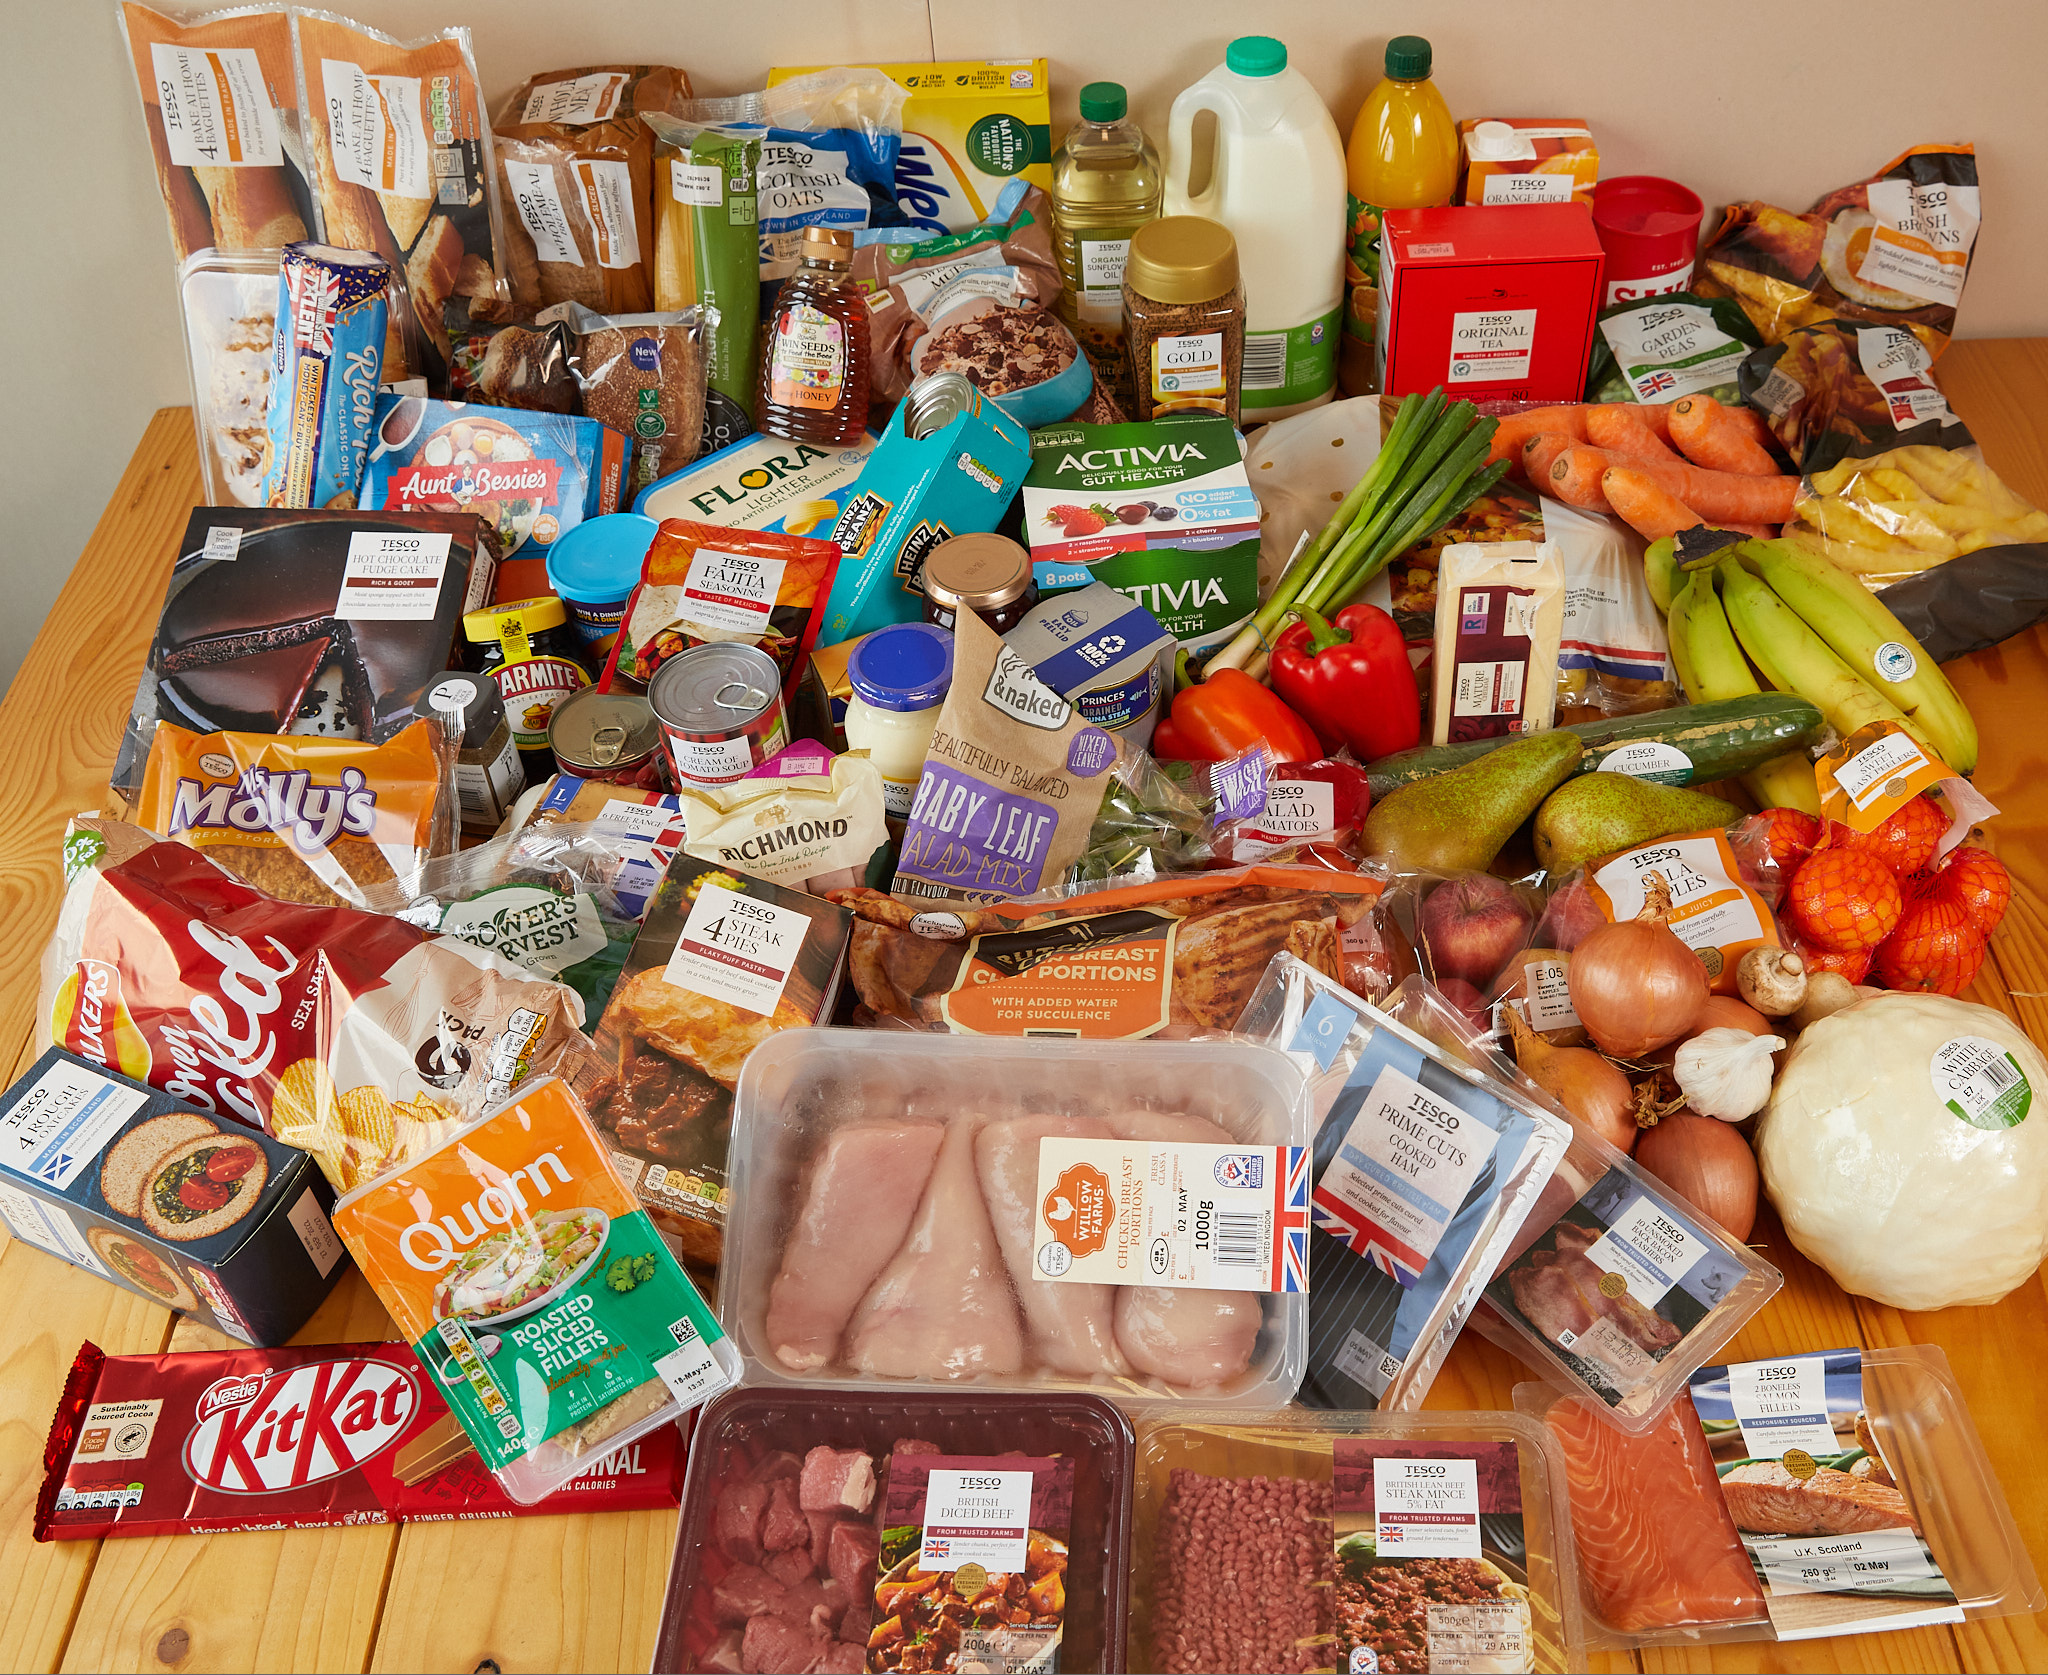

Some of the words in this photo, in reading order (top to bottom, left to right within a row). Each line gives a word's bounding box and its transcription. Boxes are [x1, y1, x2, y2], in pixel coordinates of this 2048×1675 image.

[352, 70, 363, 108] HOME
[162, 81, 178, 130] TESCO
[196, 72, 217, 143] BAGUETTES
[331, 98, 344, 148] TESCO
[351, 111, 362, 128] AT
[363, 94, 376, 166] BAGUETTES
[198, 145, 218, 160] 4
[351, 130, 362, 165] BAKE
[991, 125, 1000, 165] FAVOURITE
[999, 119, 1013, 171] NATION'S
[764, 147, 813, 167] TESCO
[359, 168, 373, 182] 4
[1511, 179, 1546, 188] TESCO
[773, 191, 824, 209] OATS
[520, 193, 543, 232] TESCO
[528, 168, 568, 256] WHOLEMEAL
[548, 198, 567, 236] BREAD
[1104, 271, 1119, 280] OIL
[1458, 326, 1528, 340] ORIGINAL
[1642, 321, 1702, 353] GARDEN
[635, 346, 657, 358] New
[1480, 339, 1504, 349] TEA
[1658, 337, 1697, 359] PEAS
[1167, 350, 1213, 364] GOLD
[307, 383, 317, 423] TICKETS
[795, 390, 832, 403] HONEY
[1056, 443, 1207, 475] ACTIVIA
[400, 471, 457, 499] Aunt
[476, 467, 547, 496] Bessie's
[689, 444, 830, 516] FLORA
[1081, 475, 1116, 487] GUT
[1121, 469, 1185, 484] HEALTH
[742, 496, 788, 523] ARTIFICIAL
[788, 467, 846, 498] INGREDIENTS
[746, 475, 811, 510] LIGHTER
[1180, 492, 1207, 504] NO
[1209, 489, 1235, 498] added
[841, 500, 875, 552] BEANZ
[1196, 527, 1217, 535] cherry
[901, 528, 930, 572] HEINZ
[1079, 537, 1110, 547] raspberry
[353, 554, 376, 564] HOT
[377, 555, 442, 564] CHOCOLATE
[362, 565, 398, 574] FUDGE
[399, 565, 429, 574] CAKE
[703, 565, 766, 590] FAJITA
[1046, 573, 1056, 585] 8
[1058, 572, 1086, 584] pots
[699, 579, 764, 599] SEASONING
[1081, 642, 1111, 665] 100%
[527, 692, 566, 704] EXTRACT
[1081, 690, 1125, 706] PRINCES
[1473, 670, 1485, 709] MATURE
[1083, 702, 1122, 717] DRAINED
[1076, 733, 1107, 752] MIXED
[679, 761, 720, 774] TOMATO
[722, 760, 749, 773] SOUP
[684, 755, 720, 766] CREAM
[724, 755, 739, 765] OF
[929, 730, 1010, 779] BEAUTIFULLY
[1010, 765, 1069, 800] BALANCED
[1072, 750, 1102, 769] LEAVES
[1614, 760, 1670, 772] CUCUMBER
[1860, 751, 1894, 775] SWEET
[236, 766, 266, 795] Ms
[1851, 773, 1873, 794] EASY
[1874, 748, 1917, 775] PEELERS
[554, 789, 567, 801] L
[170, 770, 375, 849] Molly's
[626, 806, 653, 815] TESCO
[910, 771, 987, 840] BABY
[983, 802, 1050, 864] LEAF
[719, 818, 848, 862] RICHMOND
[1630, 848, 1680, 865] TESCO
[975, 855, 1032, 892] MIX
[911, 880, 949, 899] FLAVOUR
[732, 900, 776, 921] TESCO
[1689, 898, 1714, 913] JUICY
[703, 916, 726, 942] 4
[729, 919, 784, 946] STEAK
[724, 933, 759, 955] PIES
[526, 954, 557, 965] Grown
[1038, 966, 1157, 982] PORTIONS
[1536, 967, 1563, 980] E:05
[992, 997, 1024, 1006] WITH
[1028, 998, 1064, 1007] ADDED
[1068, 998, 1118, 1007] WATER
[521, 1015, 535, 1032] 0.30g
[997, 1010, 1024, 1019] FOR
[1027, 1010, 1111, 1020] SUCCULENCE
[1317, 1015, 1335, 1037] 6
[1941, 1042, 1980, 1073] WHITE
[504, 1062, 515, 1077] 0.3g
[1948, 1047, 1997, 1090] CABBAGE
[27, 1085, 78, 1133] ROUGH
[39, 1088, 89, 1139] OATCAKES
[1412, 1093, 1460, 1130] TESCO
[19, 1136, 36, 1150] 4
[1378, 1103, 1428, 1142] PRIME
[1427, 1134, 1467, 1167] CUTS
[1389, 1133, 1437, 1170] COOKED
[1390, 1152, 1420, 1177] HAM
[1121, 1155, 1134, 1207] BREAST
[1078, 1180, 1093, 1241] WILLOW
[1178, 1187, 1189, 1213] MAY
[399, 1150, 573, 1272] Quorn
[1130, 1179, 1144, 1247] PORTIONS
[1177, 1219, 1188, 1232] 02
[1195, 1200, 1214, 1251] 1000g
[1264, 1209, 1272, 1239] KINGDOM
[1656, 1216, 1685, 1242] TESCO
[1117, 1209, 1128, 1269] CHICKEN
[1263, 1239, 1271, 1264] UNITED
[1631, 1236, 1665, 1265] RASHERS
[511, 1294, 594, 1347] ROASTED
[532, 1315, 595, 1358] SLICED
[540, 1329, 608, 1377] FILLETS
[673, 1361, 713, 1386] 18-May-22
[1757, 1366, 1796, 1379] TESCO
[1756, 1391, 1800, 1402] SALMON
[1760, 1401, 1801, 1413] FILLETS
[100, 1404, 150, 1413] Sustainably
[570, 1402, 593, 1418] PROTEIN
[207, 1362, 408, 1491] KitKat
[1404, 1466, 1446, 1474] TESCO
[575, 1480, 616, 1491] CALORIES
[960, 1477, 1001, 1486] TESCO
[957, 1498, 999, 1507] BRITISH
[1386, 1489, 1424, 1499] STEAK
[1427, 1490, 1466, 1499] MINCE
[1407, 1500, 1422, 1509] 5%
[1425, 1500, 1445, 1509] FAT
[941, 1508, 980, 1519] DICED
[983, 1509, 1014, 1520] BEEF
[1801, 1568, 1820, 1578] 260
[1854, 1561, 1867, 1571] 02
[1868, 1559, 1889, 1572] May
[963, 1639, 991, 1654] 400g
[1485, 1642, 1496, 1651] 29
[1499, 1642, 1521, 1651] APR
